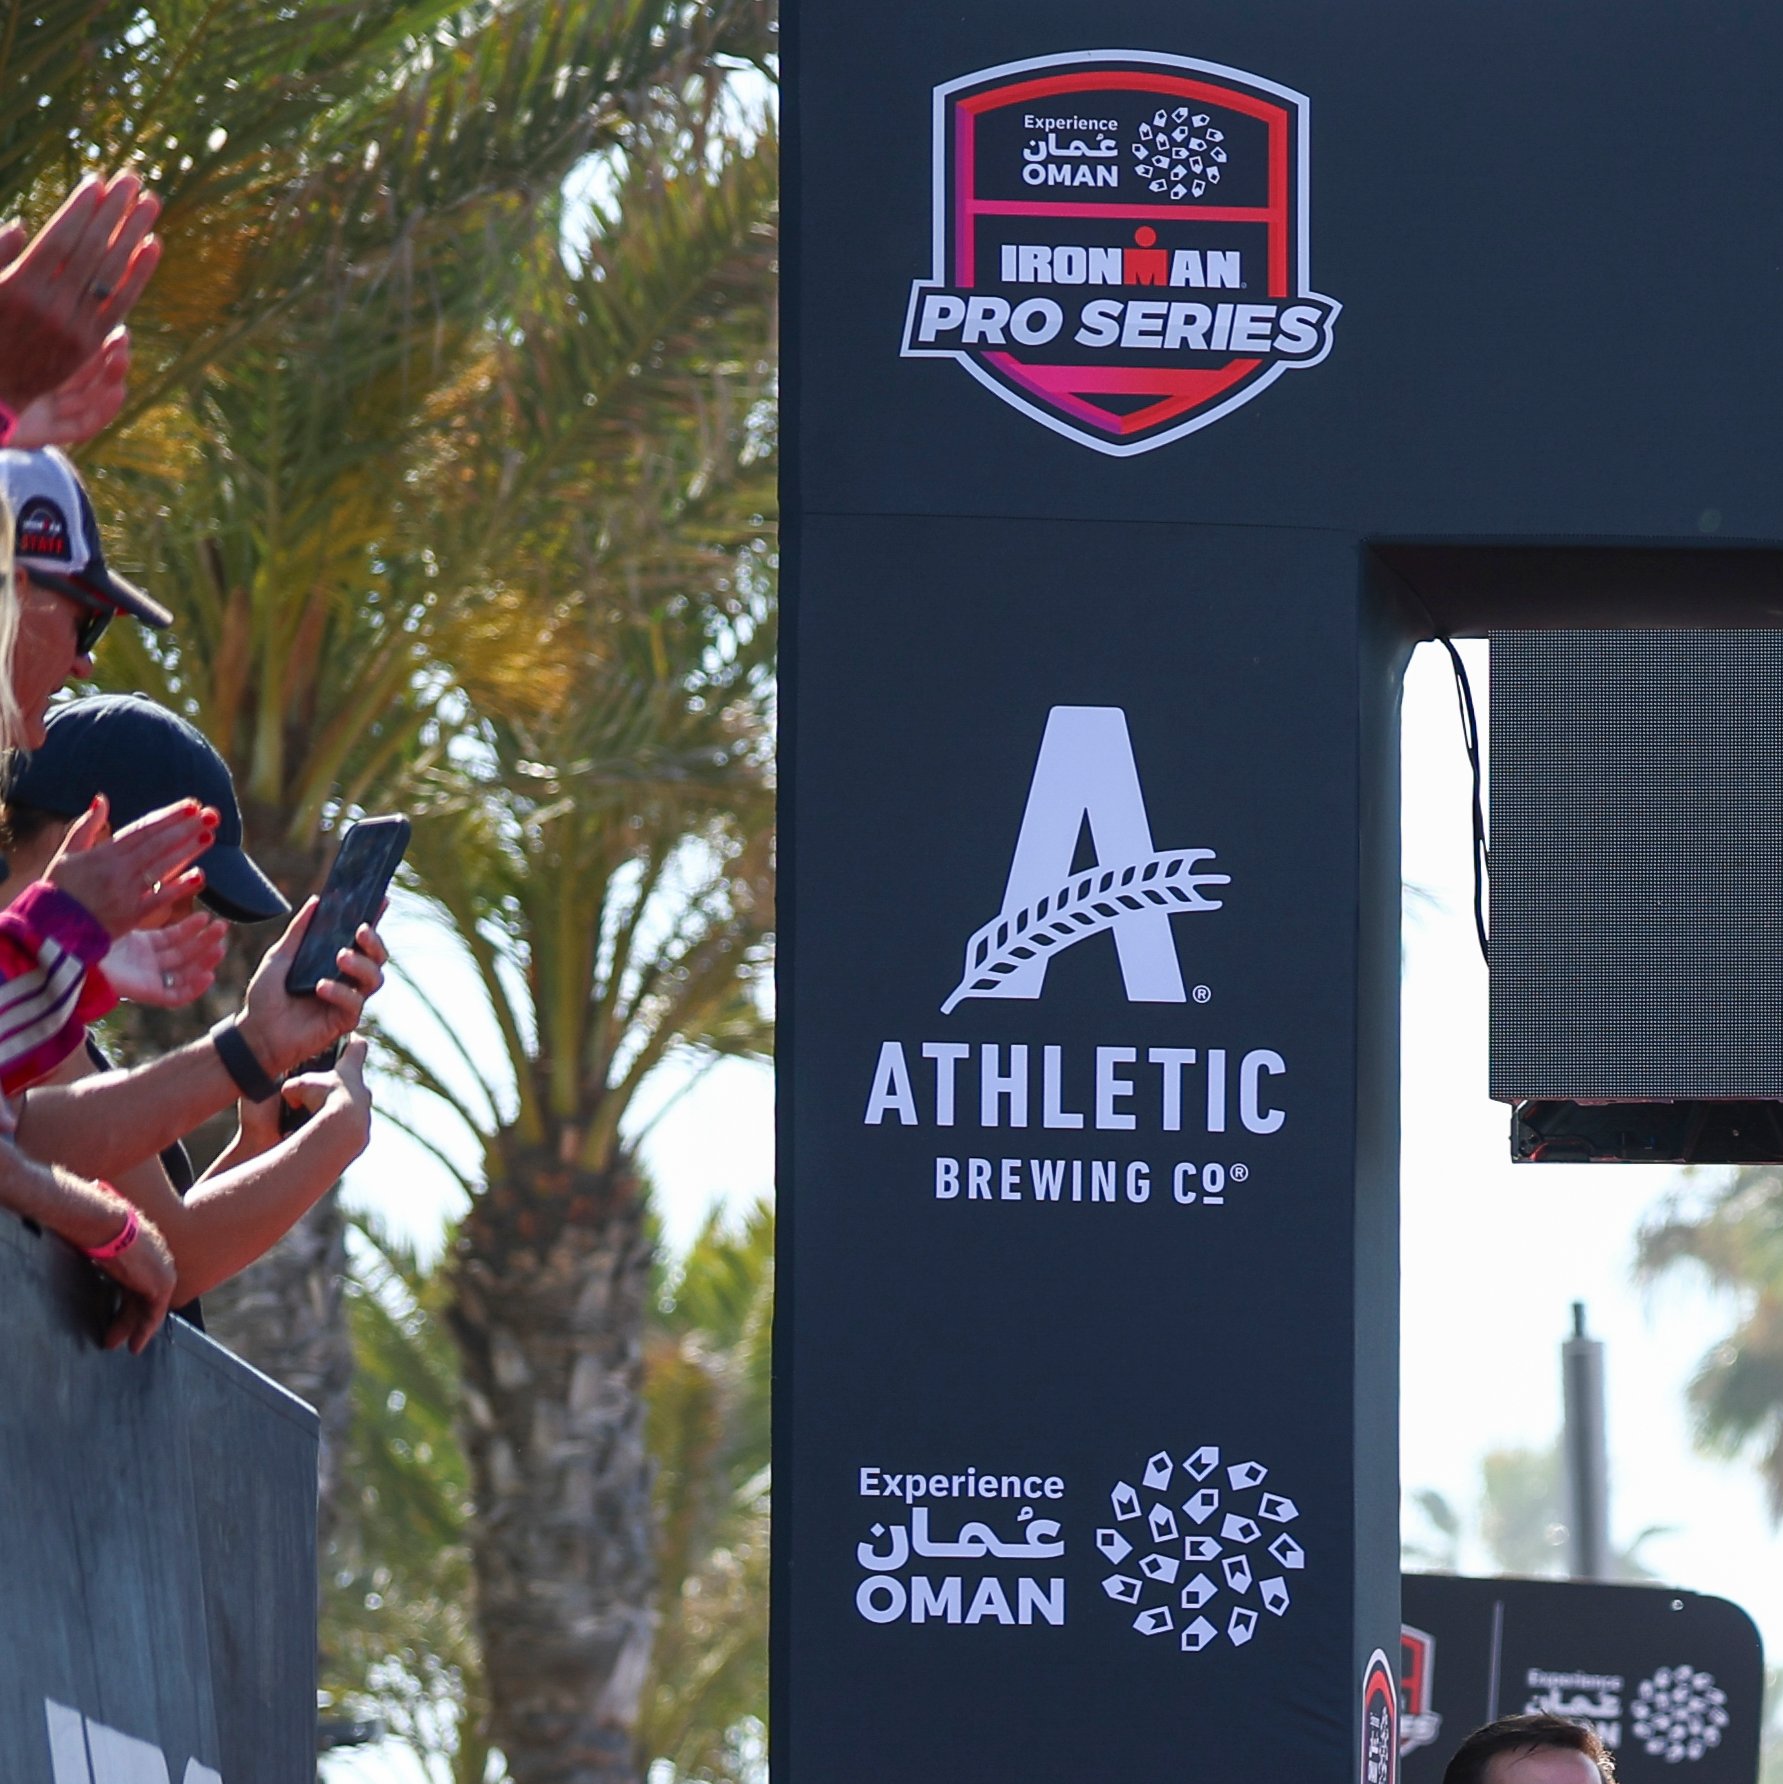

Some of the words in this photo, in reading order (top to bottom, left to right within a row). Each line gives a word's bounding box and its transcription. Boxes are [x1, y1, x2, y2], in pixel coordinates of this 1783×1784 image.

[1023, 114, 1118, 133] Experience
[1022, 163, 1118, 187] OMAN
[1001, 244, 1240, 288] IRONMAN
[919, 295, 1063, 346] PRO
[1074, 300, 1322, 352] SERIES
[864, 1041, 1287, 1134] ATHLETIC
[935, 1157, 1151, 1203] BREWING
[859, 1466, 1064, 1504] Experience
[856, 1575, 1065, 1625] OMAN
